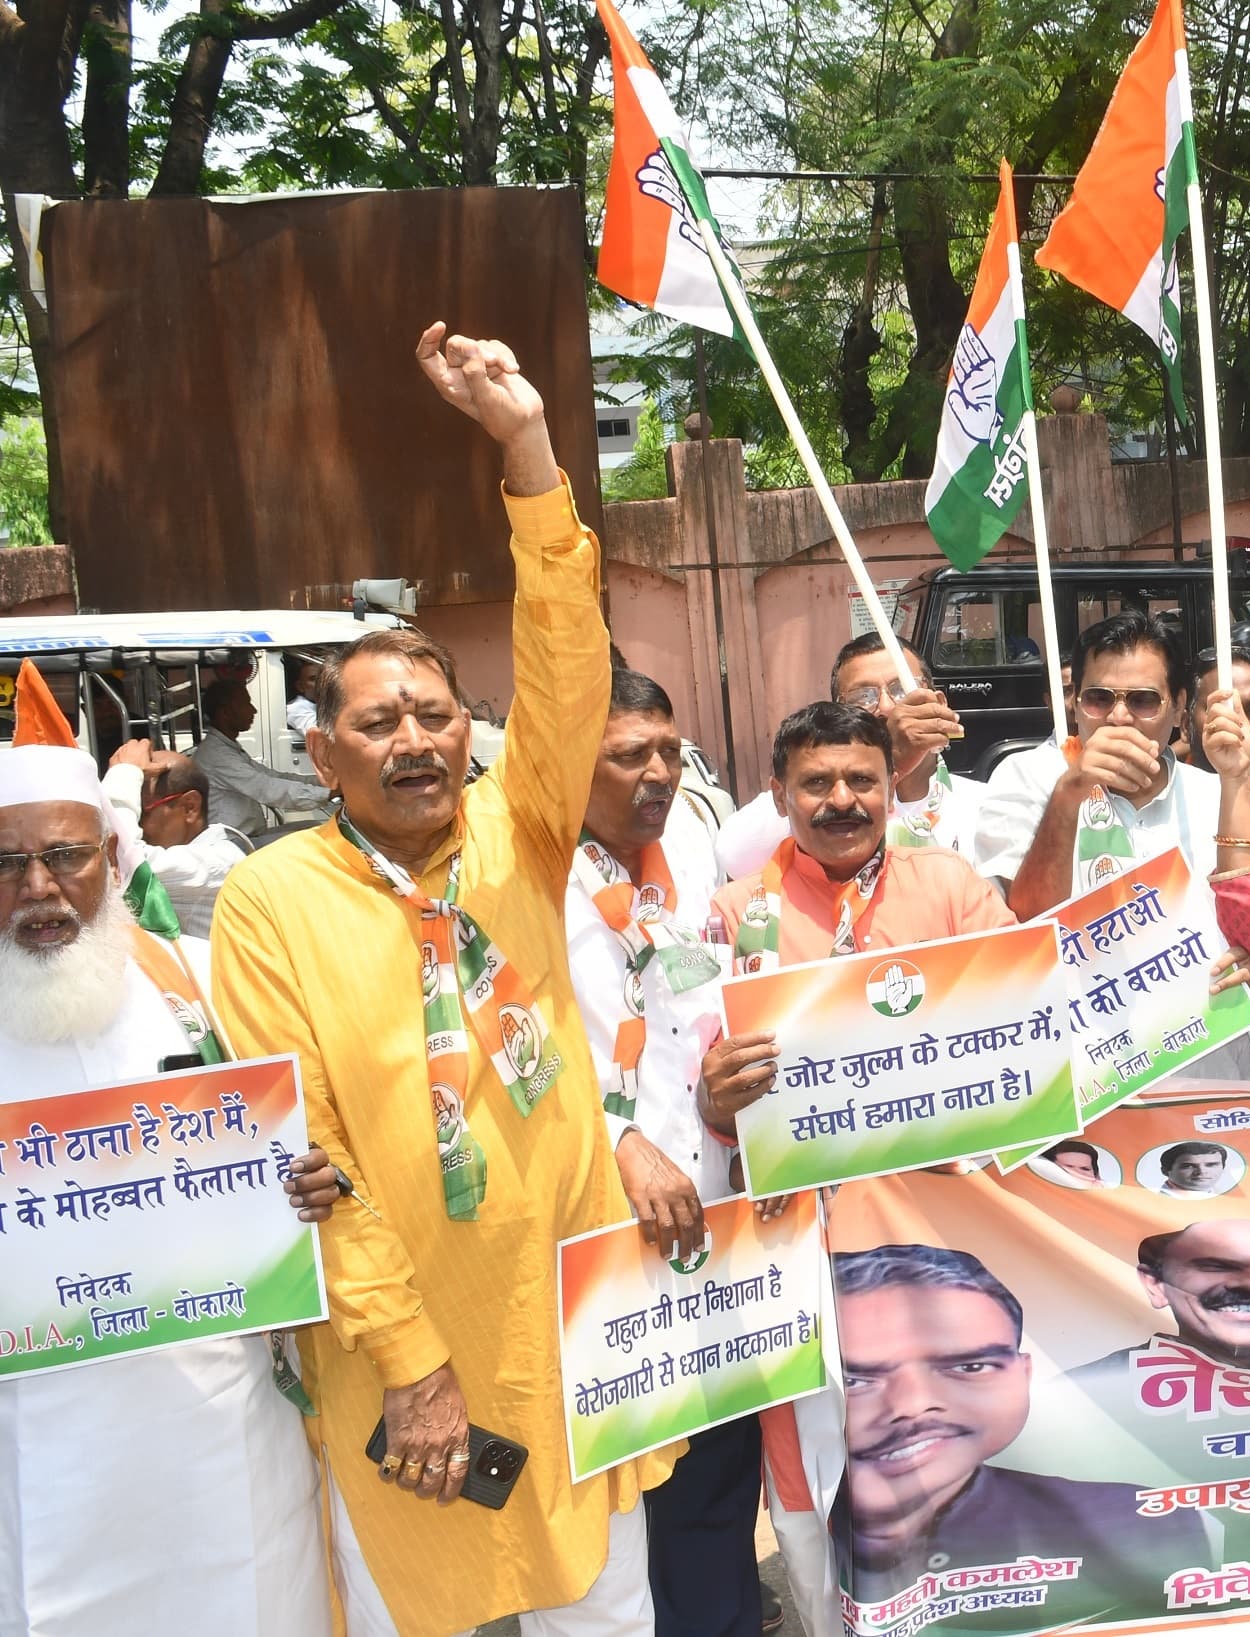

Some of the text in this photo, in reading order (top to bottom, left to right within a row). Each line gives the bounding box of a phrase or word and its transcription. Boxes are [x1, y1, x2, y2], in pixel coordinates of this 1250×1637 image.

[1086, 885, 1167, 954] हटाओ
[1086, 927, 1210, 1015] को बचाओ
[427, 1036, 454, 1053] RESS
[784, 1056, 836, 1089] जोर
[840, 1046, 903, 1089] जुल्म
[910, 1033, 939, 1066] के
[946, 1021, 1023, 1059] टक्कर
[1028, 1005, 1061, 1042] में,
[1085, 1028, 1134, 1065] निवेदक
[1113, 1050, 1152, 1081] जिला
[1162, 1016, 1208, 1052] बोकारो
[16, 1124, 57, 1168] भी
[64, 1122, 132, 1162] ठाना
[135, 1105, 161, 1153] है
[164, 1103, 217, 1144] देश
[222, 1093, 259, 1140] में,
[790, 1067, 1033, 1142] संघर्ष हमारा नारा है।
[16, 1187, 46, 1229] के
[54, 1180, 166, 1223] मोहब्बत
[174, 1158, 267, 1200] फैलाना
[56, 1272, 133, 1307] निवेदक
[92, 1306, 148, 1338] जिला
[174, 1281, 245, 1320] बोकारो
[603, 1263, 783, 1353] राहुल जी पर निशाना है
[575, 1309, 820, 1417] बेरोजगारी से ध्यान भटकाना है।
[870, 1576, 939, 1622] महतो
[947, 1559, 1078, 1588] कमलेश
[912, 1598, 959, 1631] प्रदेश
[965, 1588, 1044, 1611] अध्यक्ष
